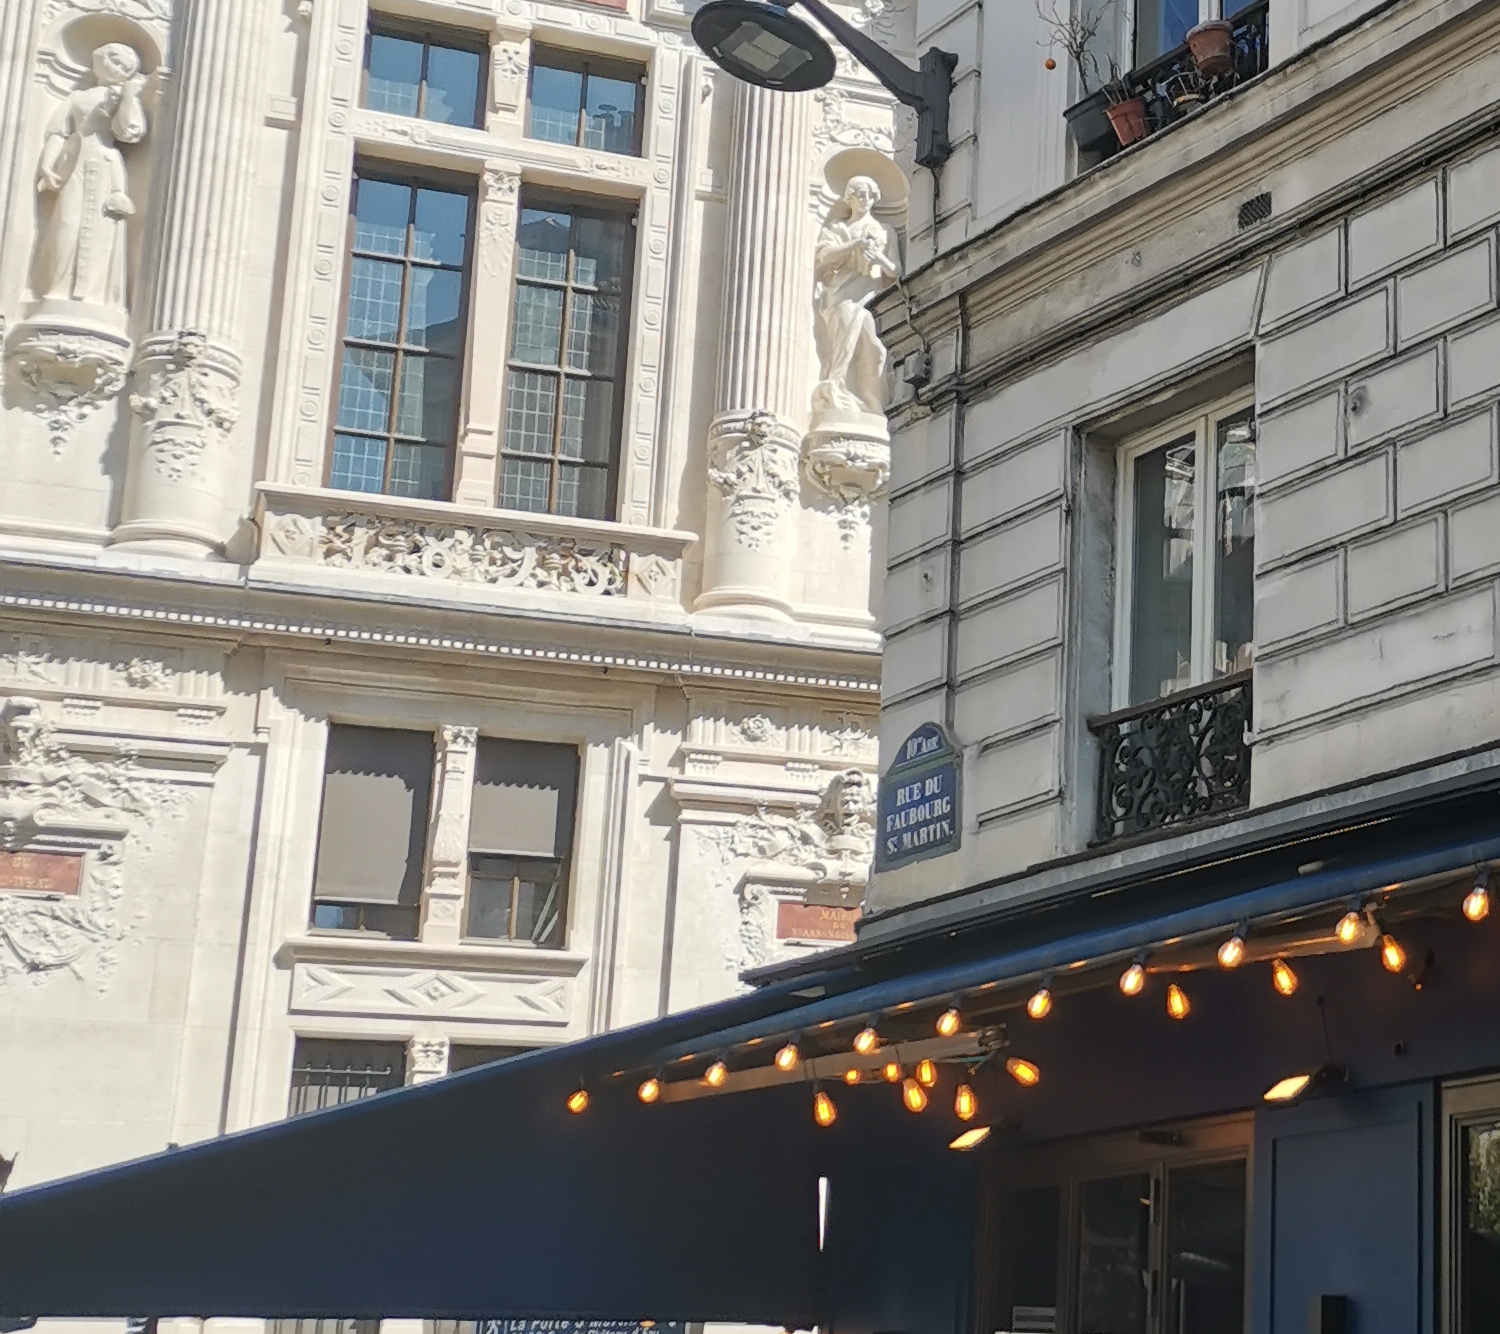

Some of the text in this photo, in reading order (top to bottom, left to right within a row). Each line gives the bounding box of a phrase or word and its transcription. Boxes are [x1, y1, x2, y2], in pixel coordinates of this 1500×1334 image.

[896, 774, 943, 806] RUE DU
[886, 796, 952, 833] FAUBOURG
